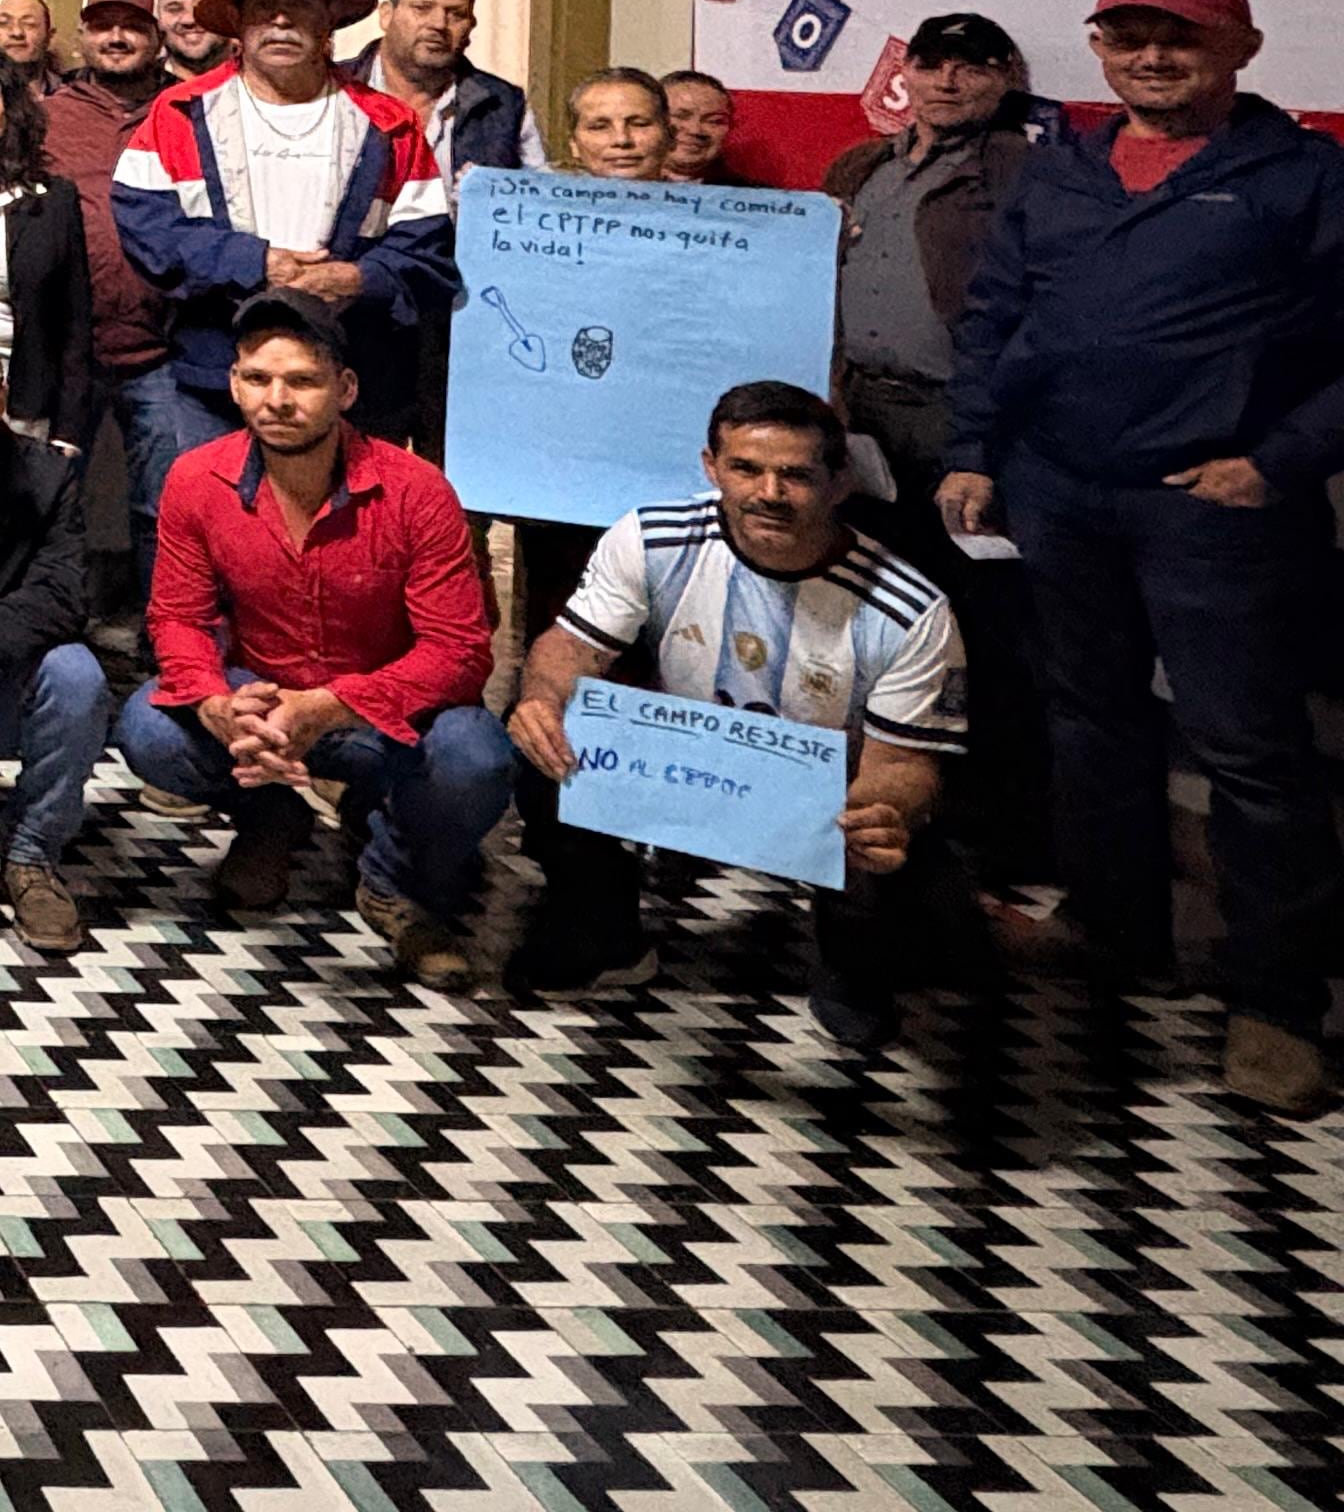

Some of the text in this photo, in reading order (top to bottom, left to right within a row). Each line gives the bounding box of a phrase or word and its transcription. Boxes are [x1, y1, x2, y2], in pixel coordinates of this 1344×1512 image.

[792, 13, 822, 49] O
[882, 73, 910, 111] S
[551, 185, 617, 205] campo
[626, 190, 651, 201] no
[663, 189, 702, 215] hay
[719, 198, 807, 217] comida
[492, 203, 750, 252] el CPTPP nos quita
[492, 230, 585, 266] la vida!
[583, 689, 619, 712] EL
[639, 702, 720, 732] CAMPO
[578, 746, 619, 771] NO
